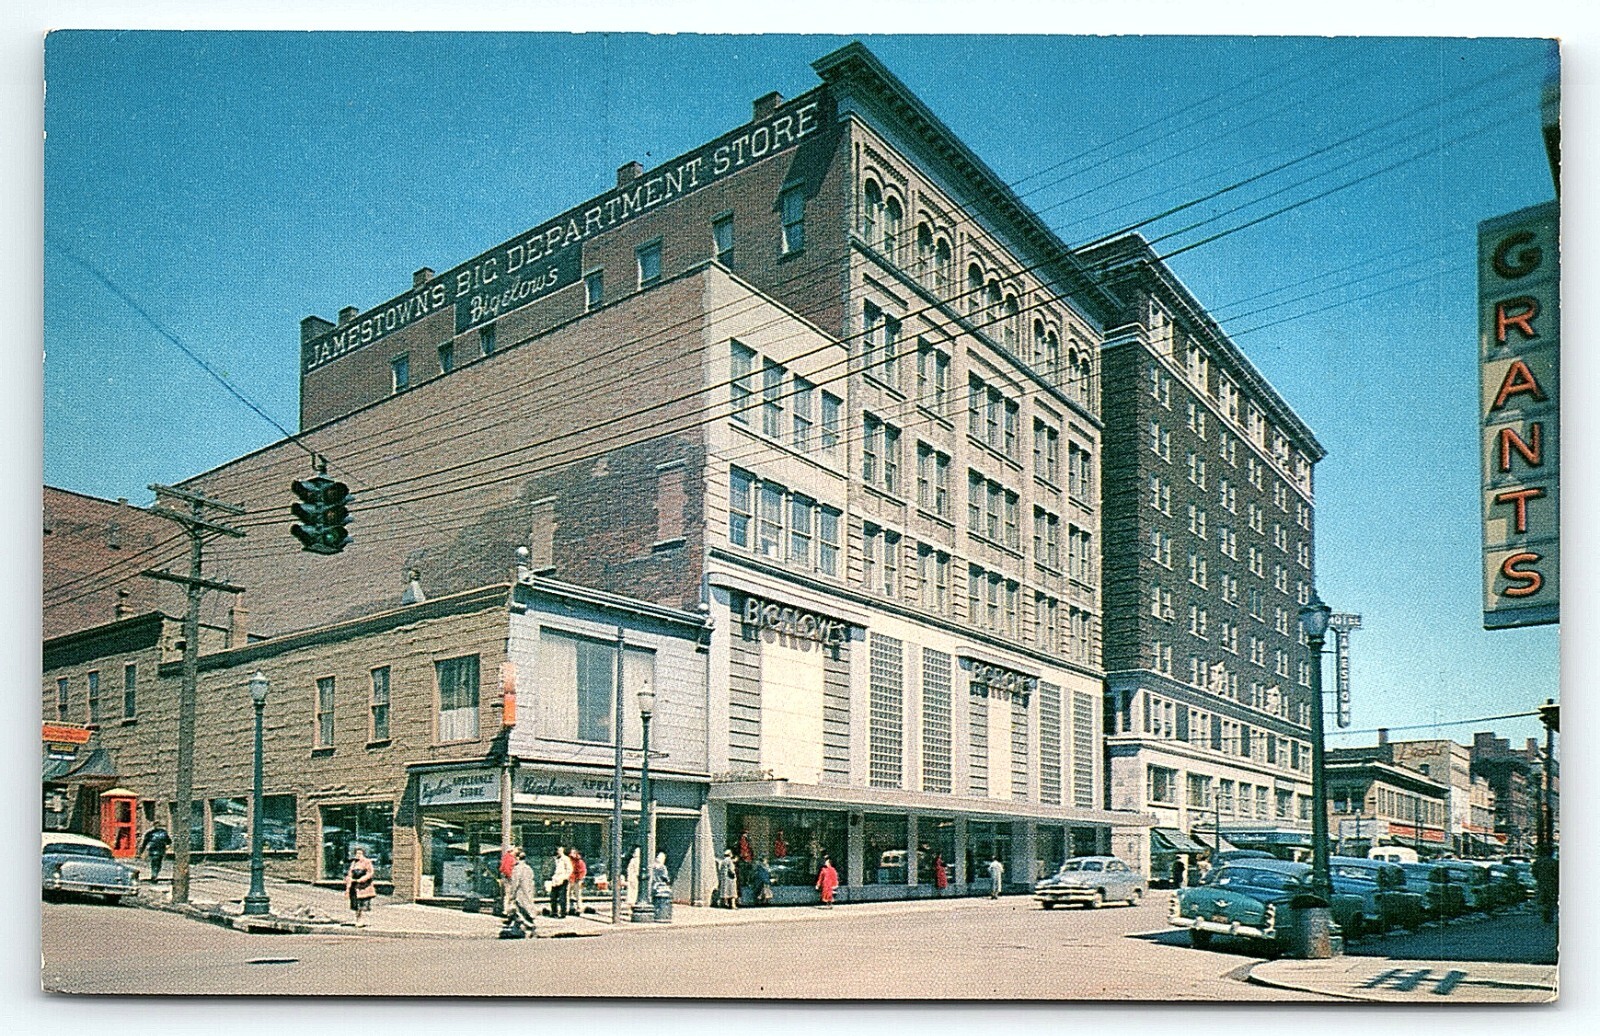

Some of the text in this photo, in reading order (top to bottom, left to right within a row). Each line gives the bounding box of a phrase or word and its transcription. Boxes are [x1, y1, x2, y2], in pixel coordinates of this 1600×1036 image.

[507, 156, 703, 274] DEPARTMENT
[713, 102, 818, 175] STORE
[1491, 230, 1545, 598] GRANTS
[460, 786, 485, 798] STORE
